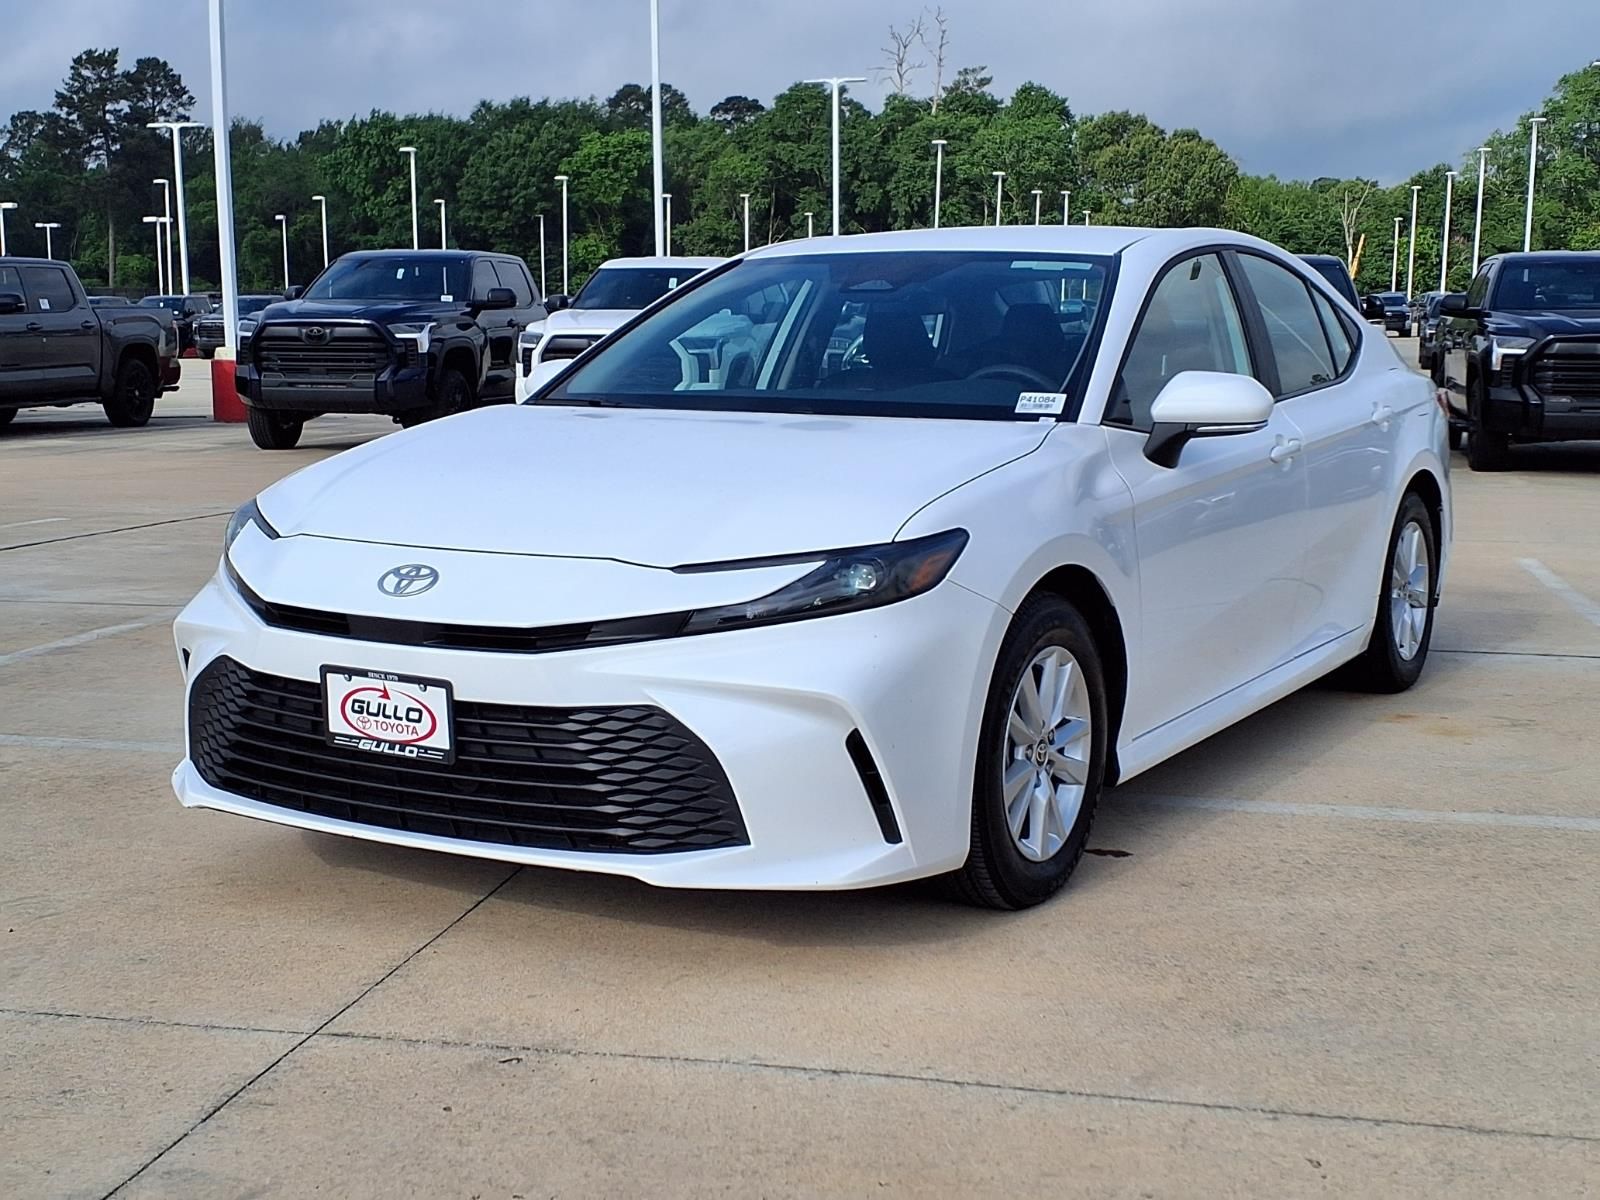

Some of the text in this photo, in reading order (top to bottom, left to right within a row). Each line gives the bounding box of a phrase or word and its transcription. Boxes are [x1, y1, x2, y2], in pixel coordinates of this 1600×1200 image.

[351, 698, 423, 723] GULLO
[373, 719, 419, 736] TOYOTA
[358, 739, 418, 758] GULLO
